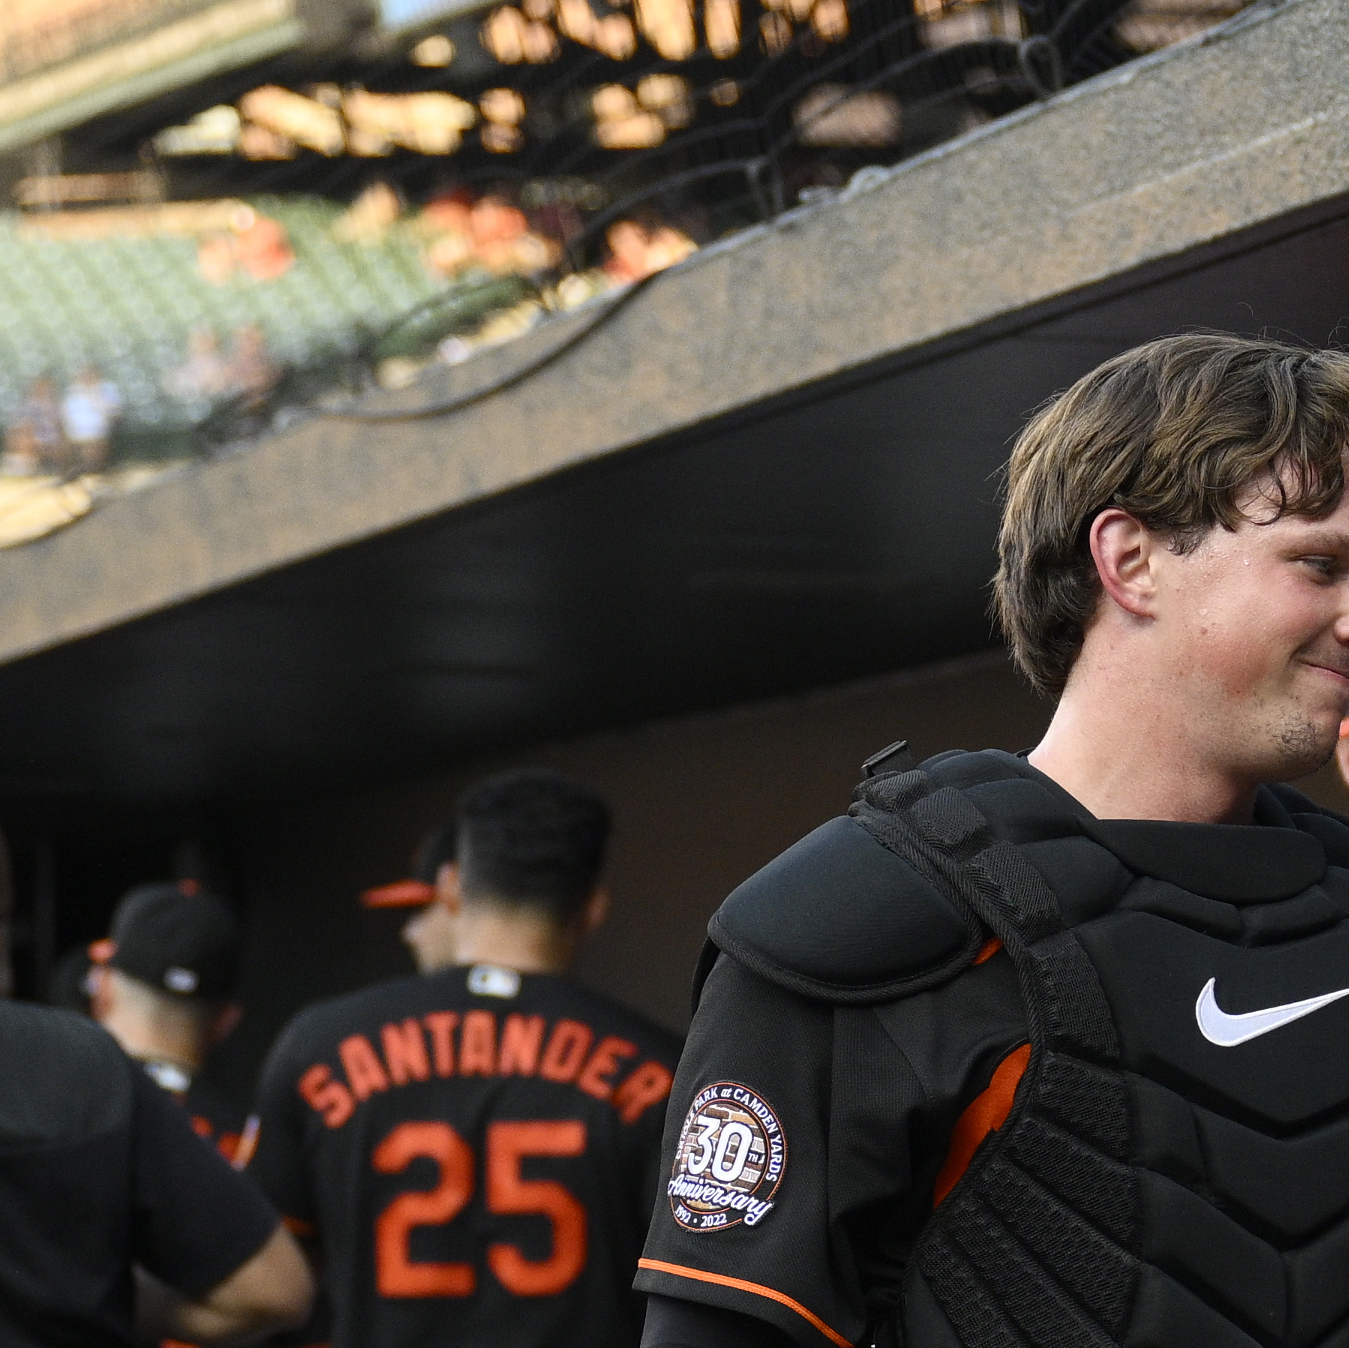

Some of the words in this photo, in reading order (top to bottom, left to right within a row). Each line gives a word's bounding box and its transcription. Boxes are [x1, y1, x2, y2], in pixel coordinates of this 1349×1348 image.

[297, 1011, 674, 1126] SANTANDER
[694, 1087, 718, 1111] PARK
[733, 1088, 778, 1134] CAMDEN
[765, 1134, 783, 1182] YARDS
[370, 1119, 587, 1299] 25
[668, 1174, 774, 1226] Anniversary
[675, 1205, 691, 1224] 1992
[700, 1213, 727, 1227] 2022
